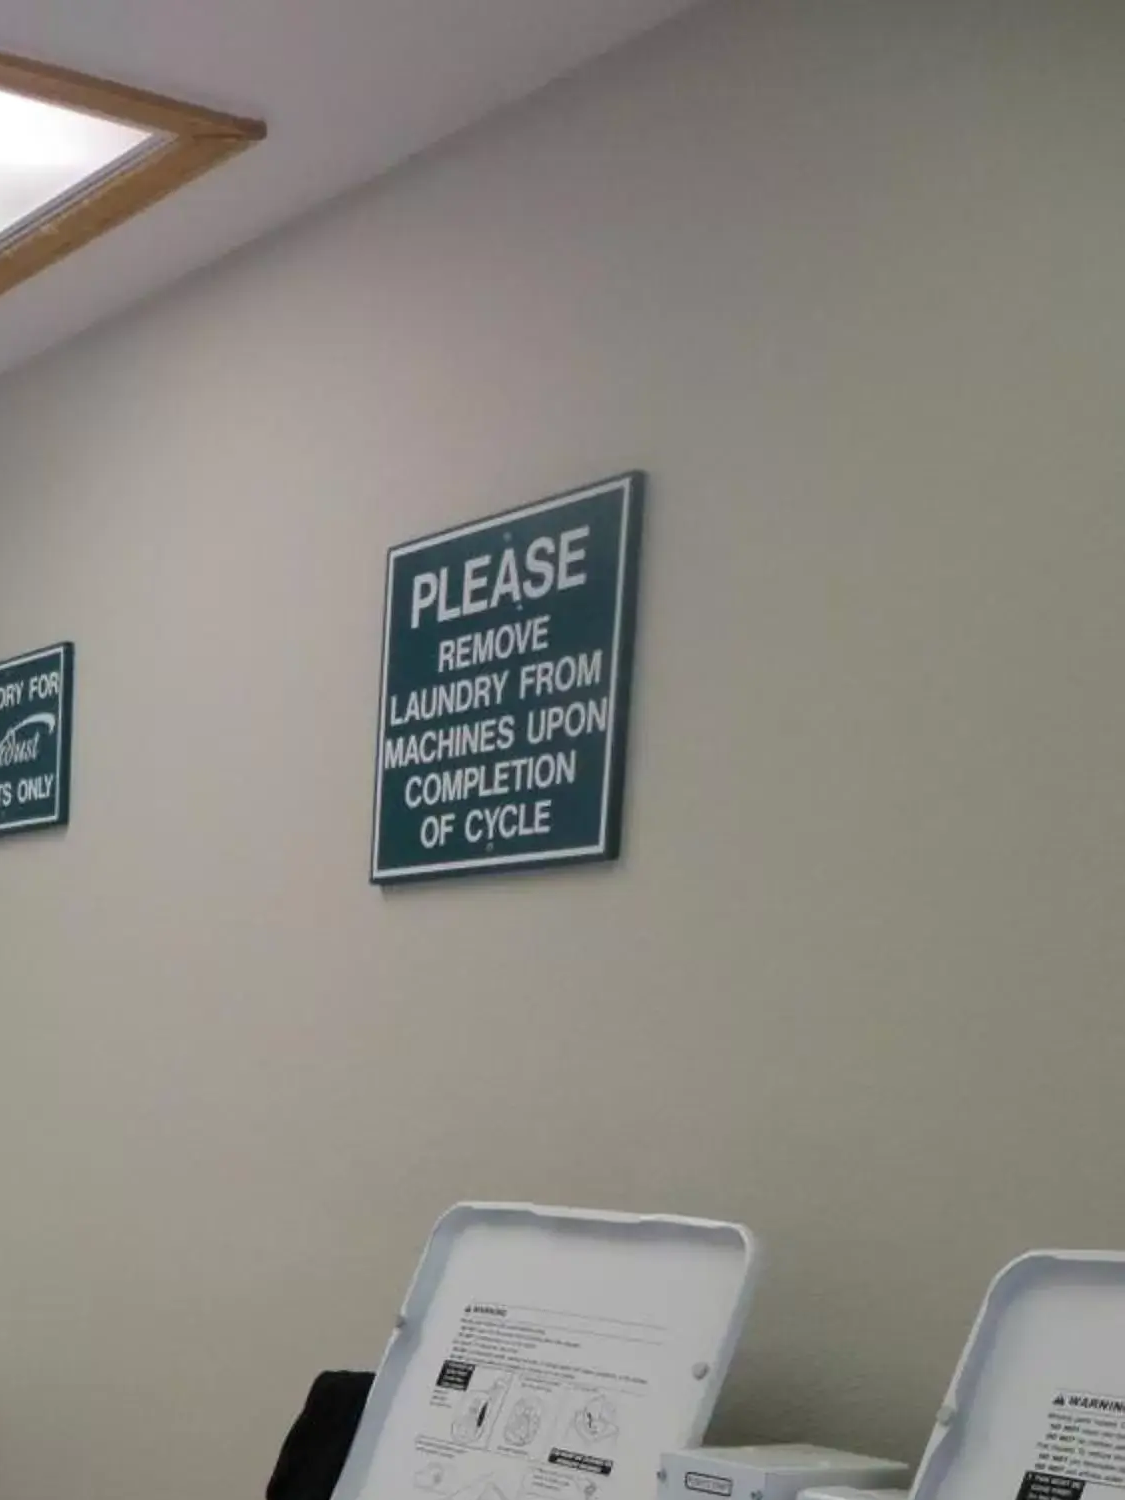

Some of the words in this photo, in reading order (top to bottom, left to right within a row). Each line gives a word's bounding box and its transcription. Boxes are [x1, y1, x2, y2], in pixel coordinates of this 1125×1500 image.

[410, 525, 590, 629] PLEASE
[438, 615, 550, 673] REMOVE
[29, 671, 59, 701] FOR
[390, 670, 510, 726] LAUNDRY
[519, 650, 603, 699] FROM
[384, 715, 515, 769] MACHINES
[528, 697, 608, 744] UPON
[17, 774, 54, 804] ONLY
[405, 750, 577, 808] COMPLETION
[420, 813, 456, 849] OF
[465, 800, 552, 844] CYCLE
[1069, 1395, 1125, 1413] WARNIN
